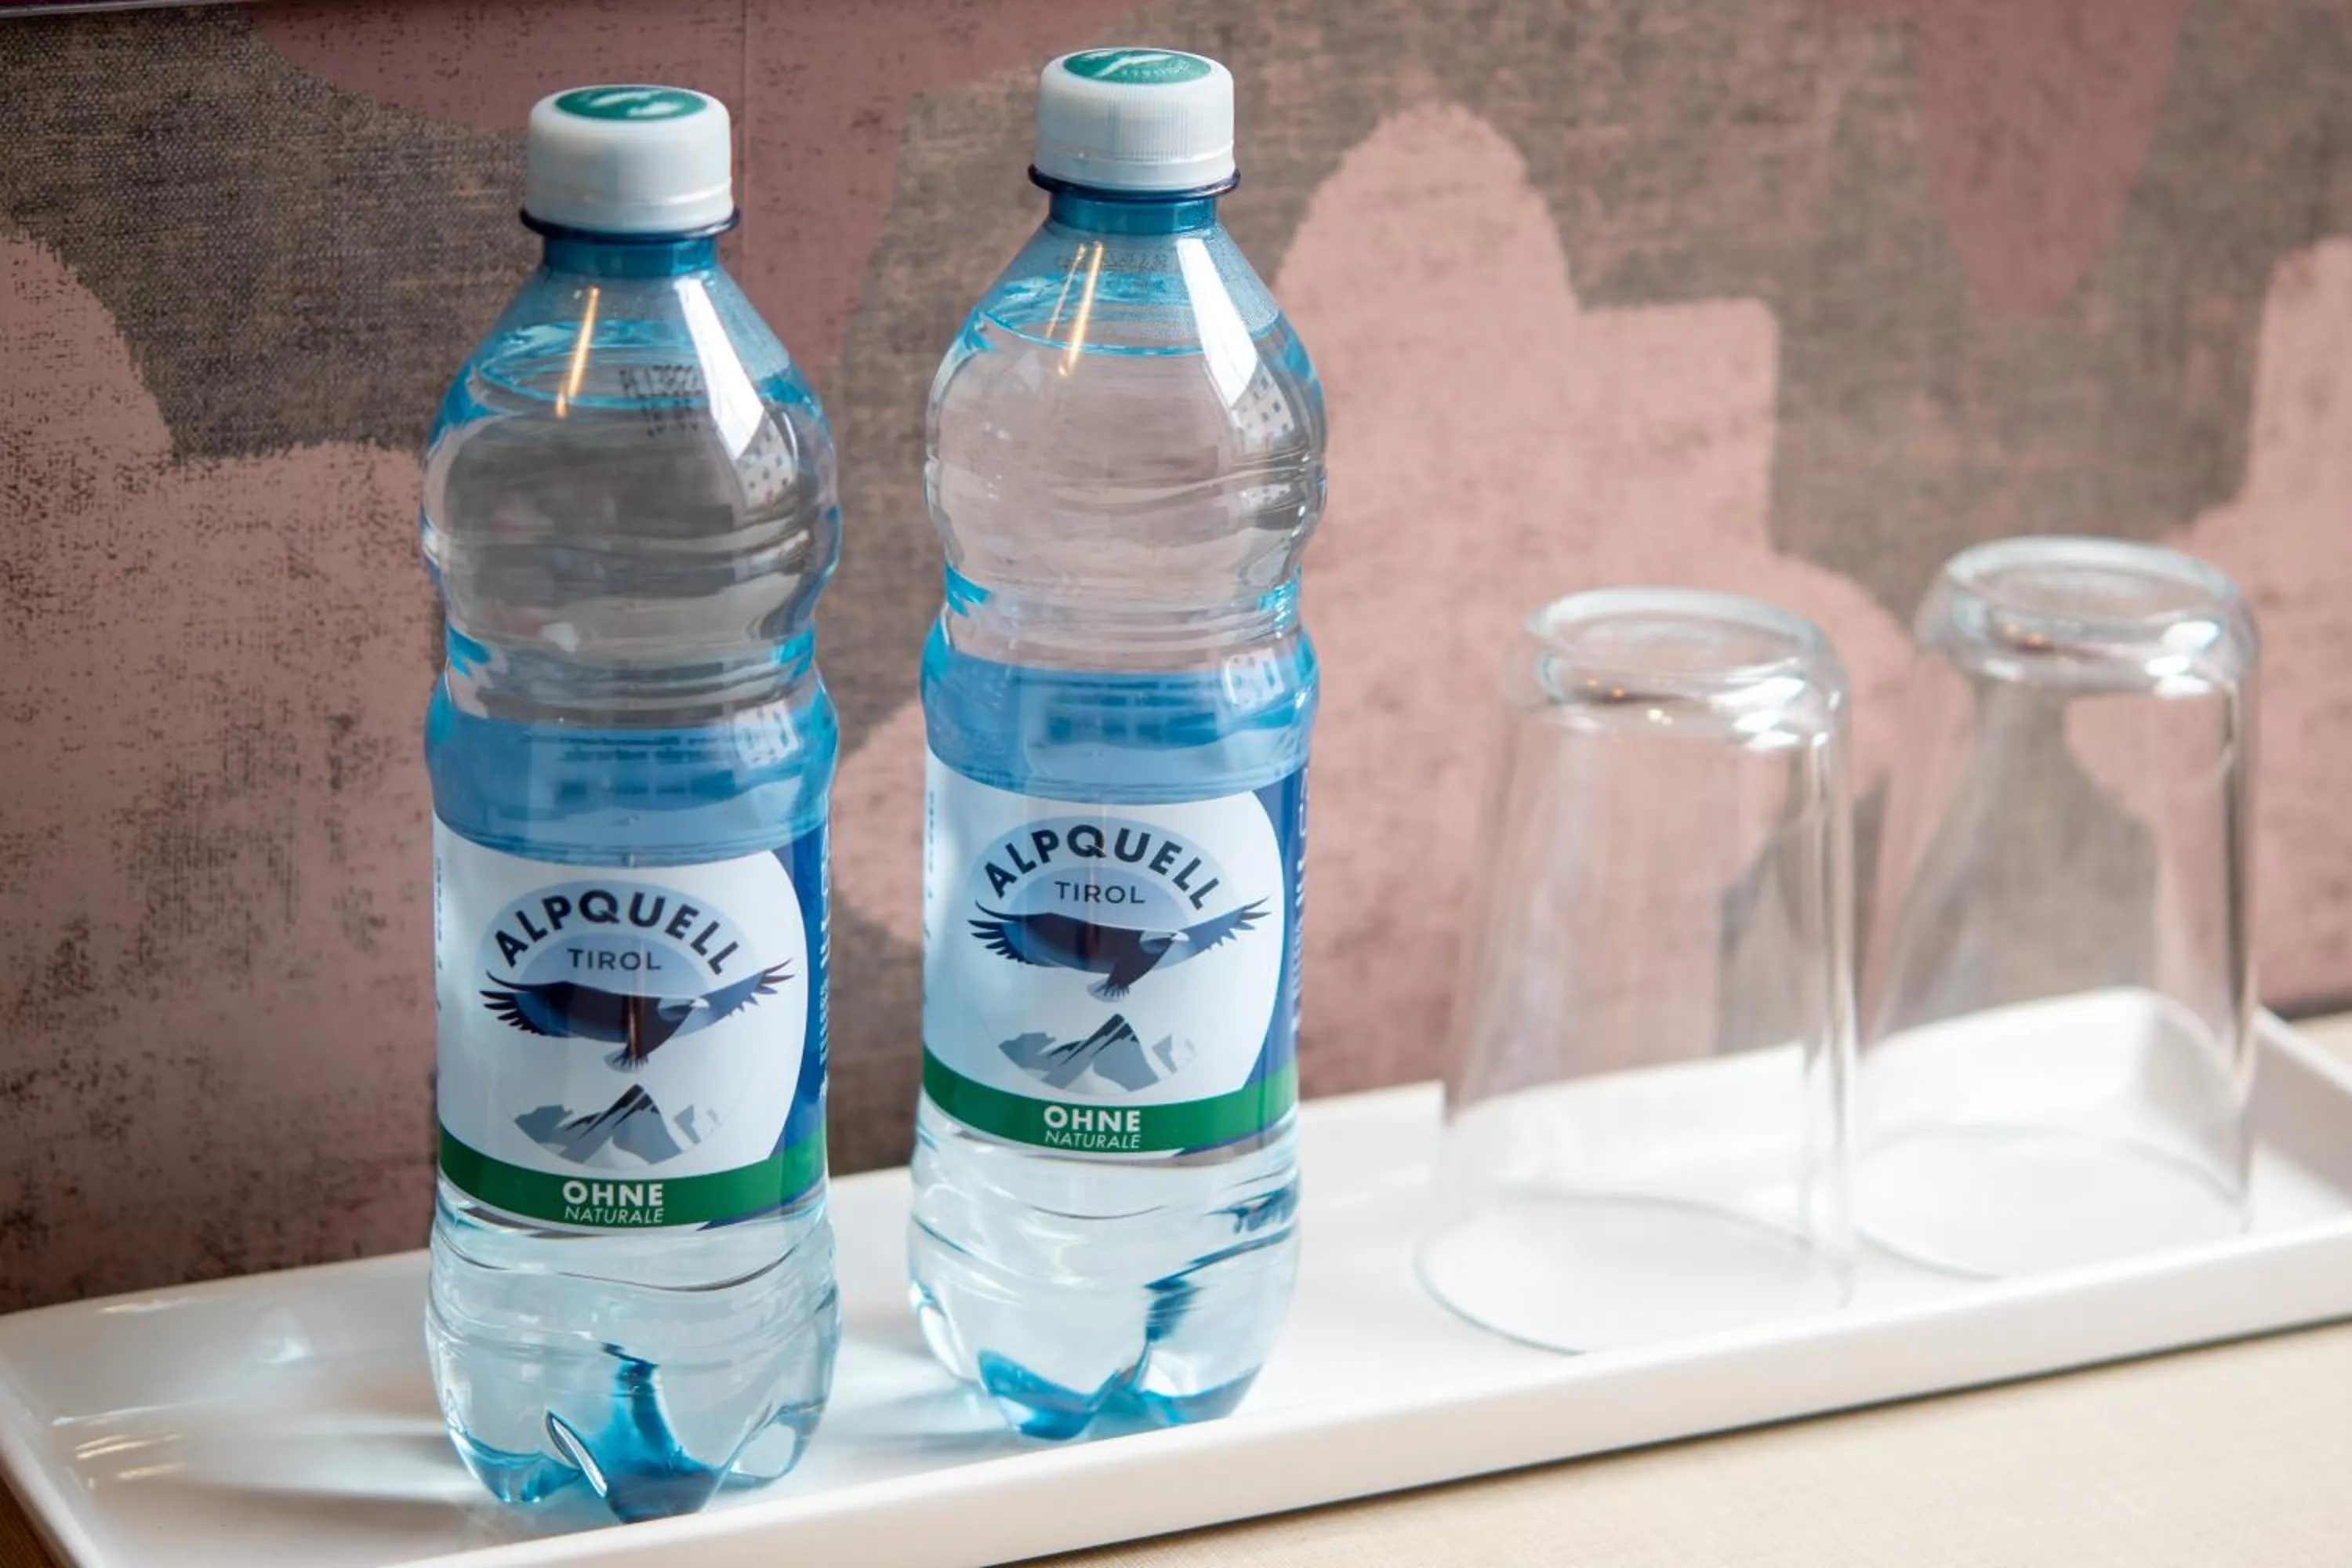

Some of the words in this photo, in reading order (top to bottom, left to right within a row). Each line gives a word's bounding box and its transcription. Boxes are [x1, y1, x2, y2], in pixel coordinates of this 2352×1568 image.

[984, 824, 1220, 910] ALPQUELL
[1054, 880, 1145, 904] TIROL
[492, 889, 739, 975] ALPQUELL
[567, 948, 661, 971] TIROL
[1044, 1105, 1141, 1133] OHNE
[1045, 1130, 1141, 1149] NATURALE
[562, 1180, 663, 1207] OHNE
[564, 1205, 663, 1225] NATURALE
